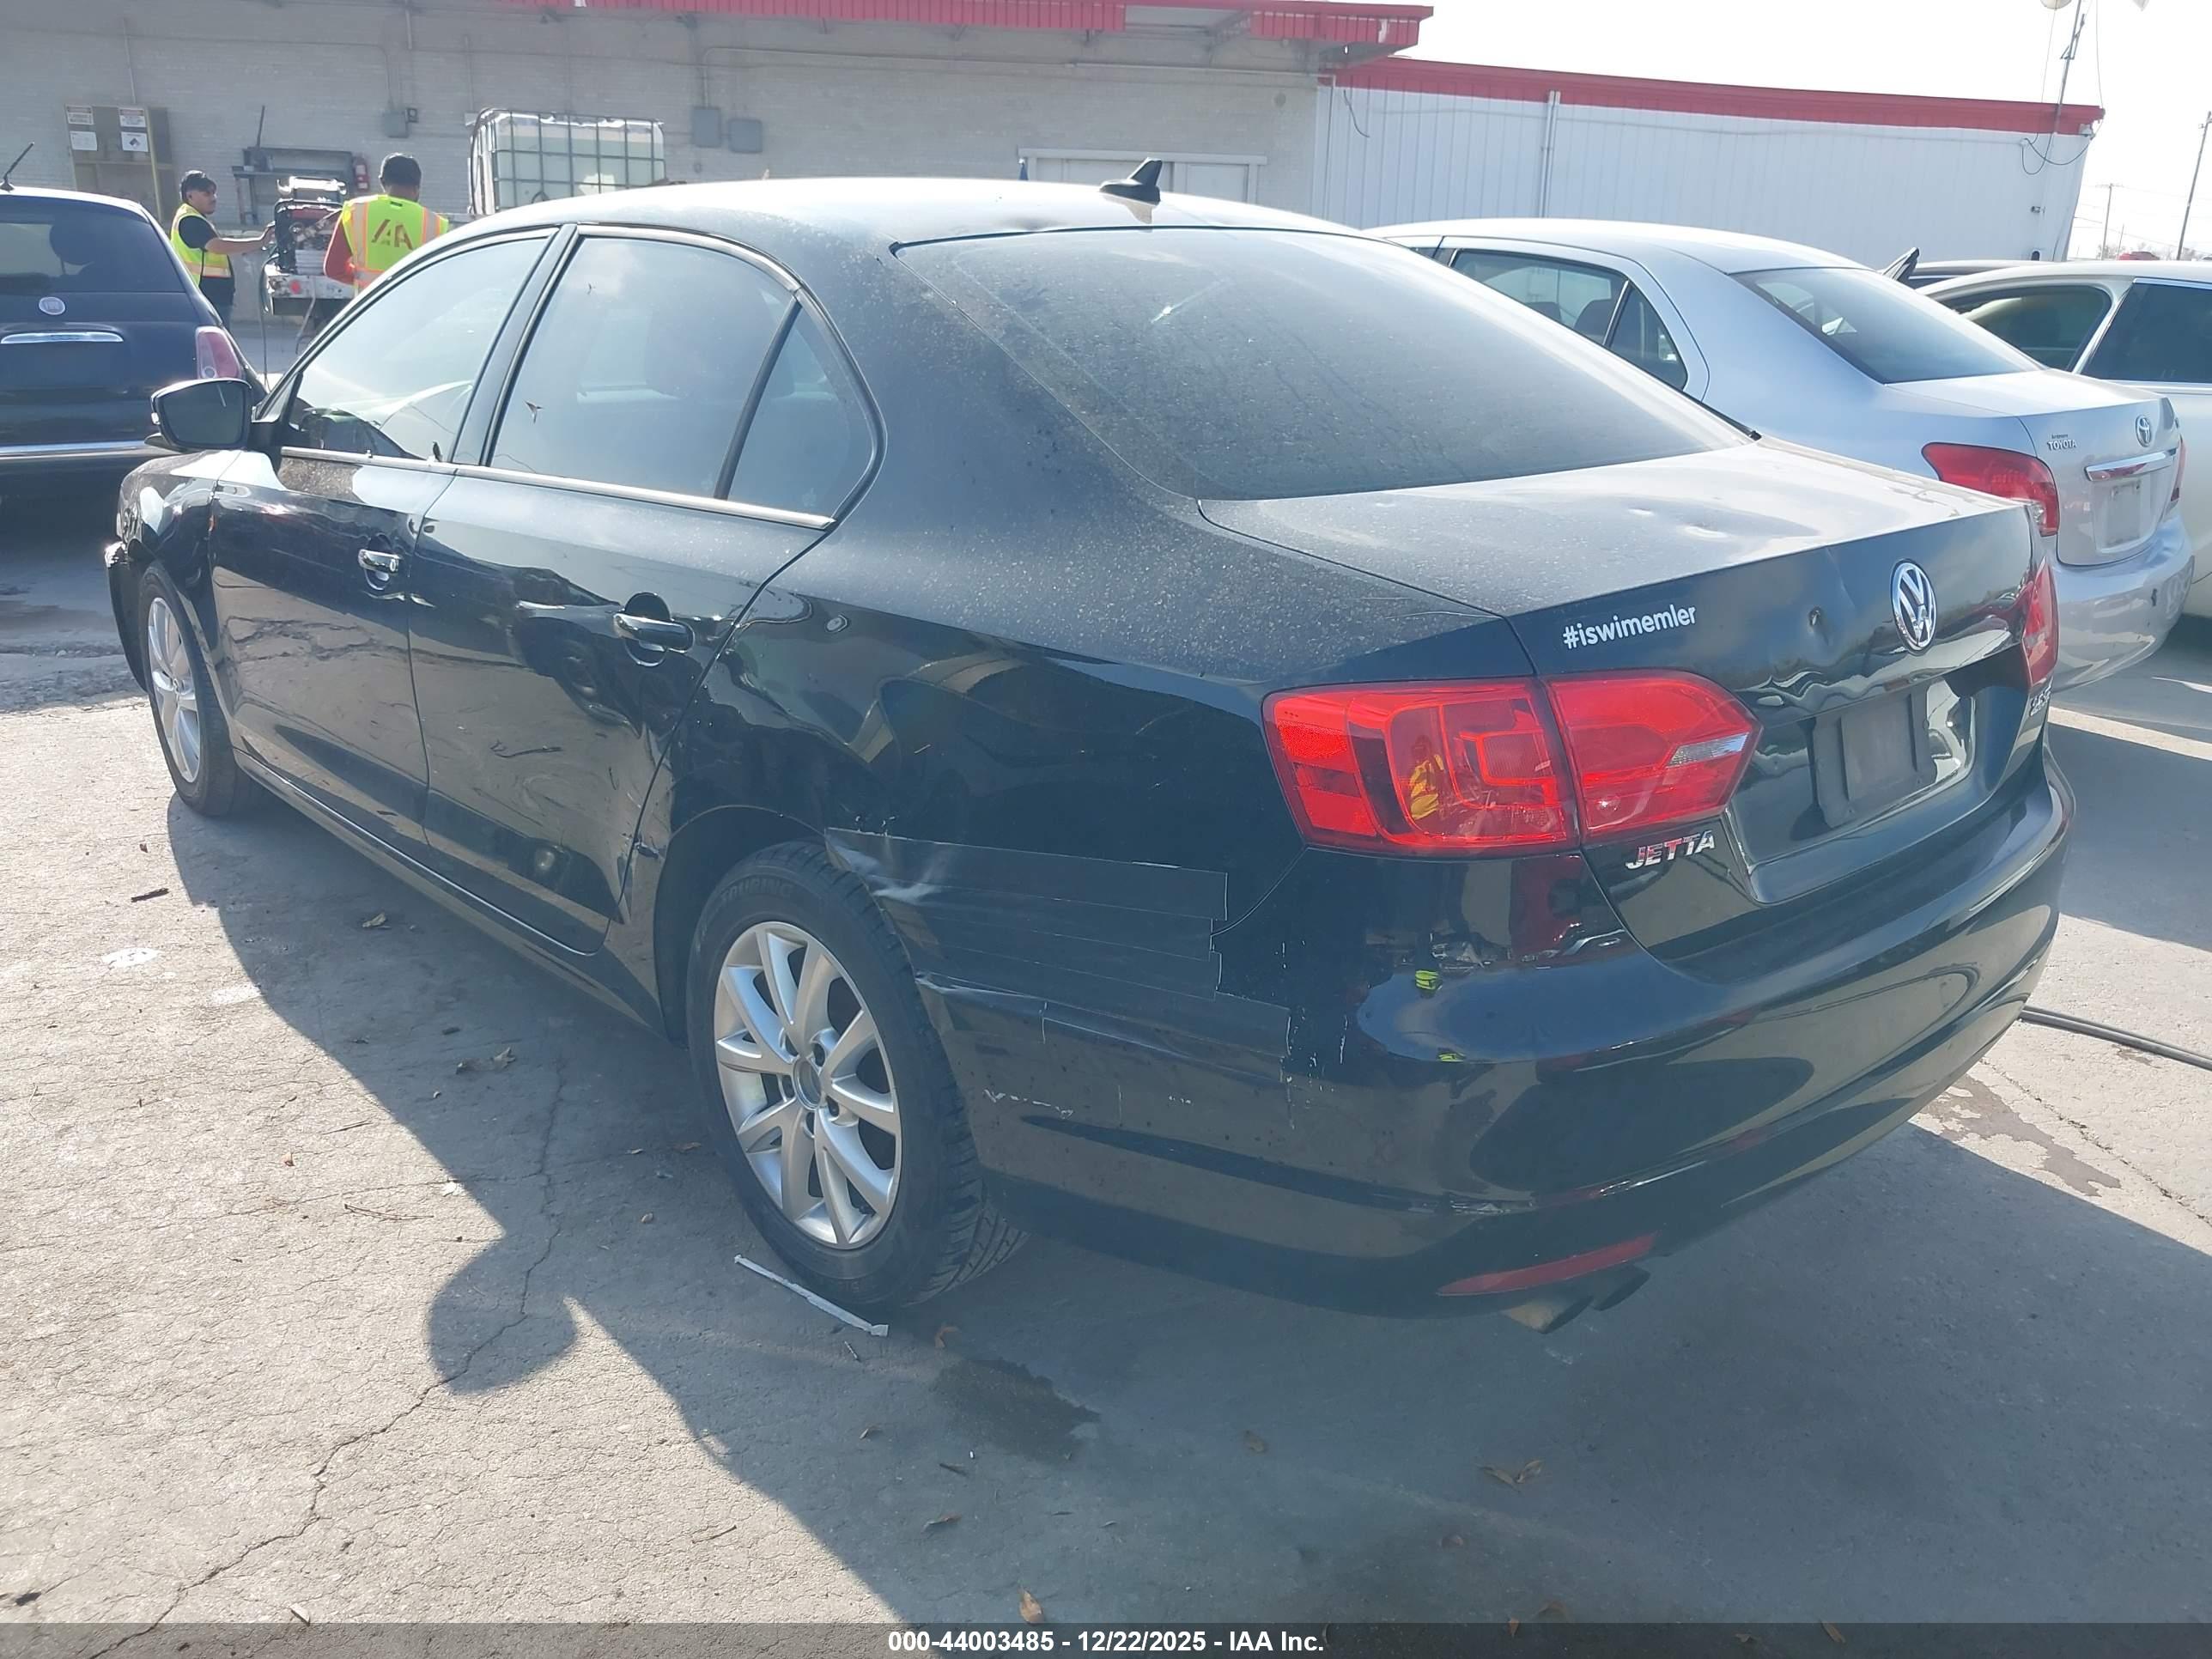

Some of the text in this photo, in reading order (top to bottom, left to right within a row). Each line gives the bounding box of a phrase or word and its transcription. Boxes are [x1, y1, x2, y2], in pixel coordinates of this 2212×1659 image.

[2047, 439, 2078, 451] TOYOTA
[1562, 604, 1697, 650] #iswimemler
[1625, 830, 1715, 870] JETTA
